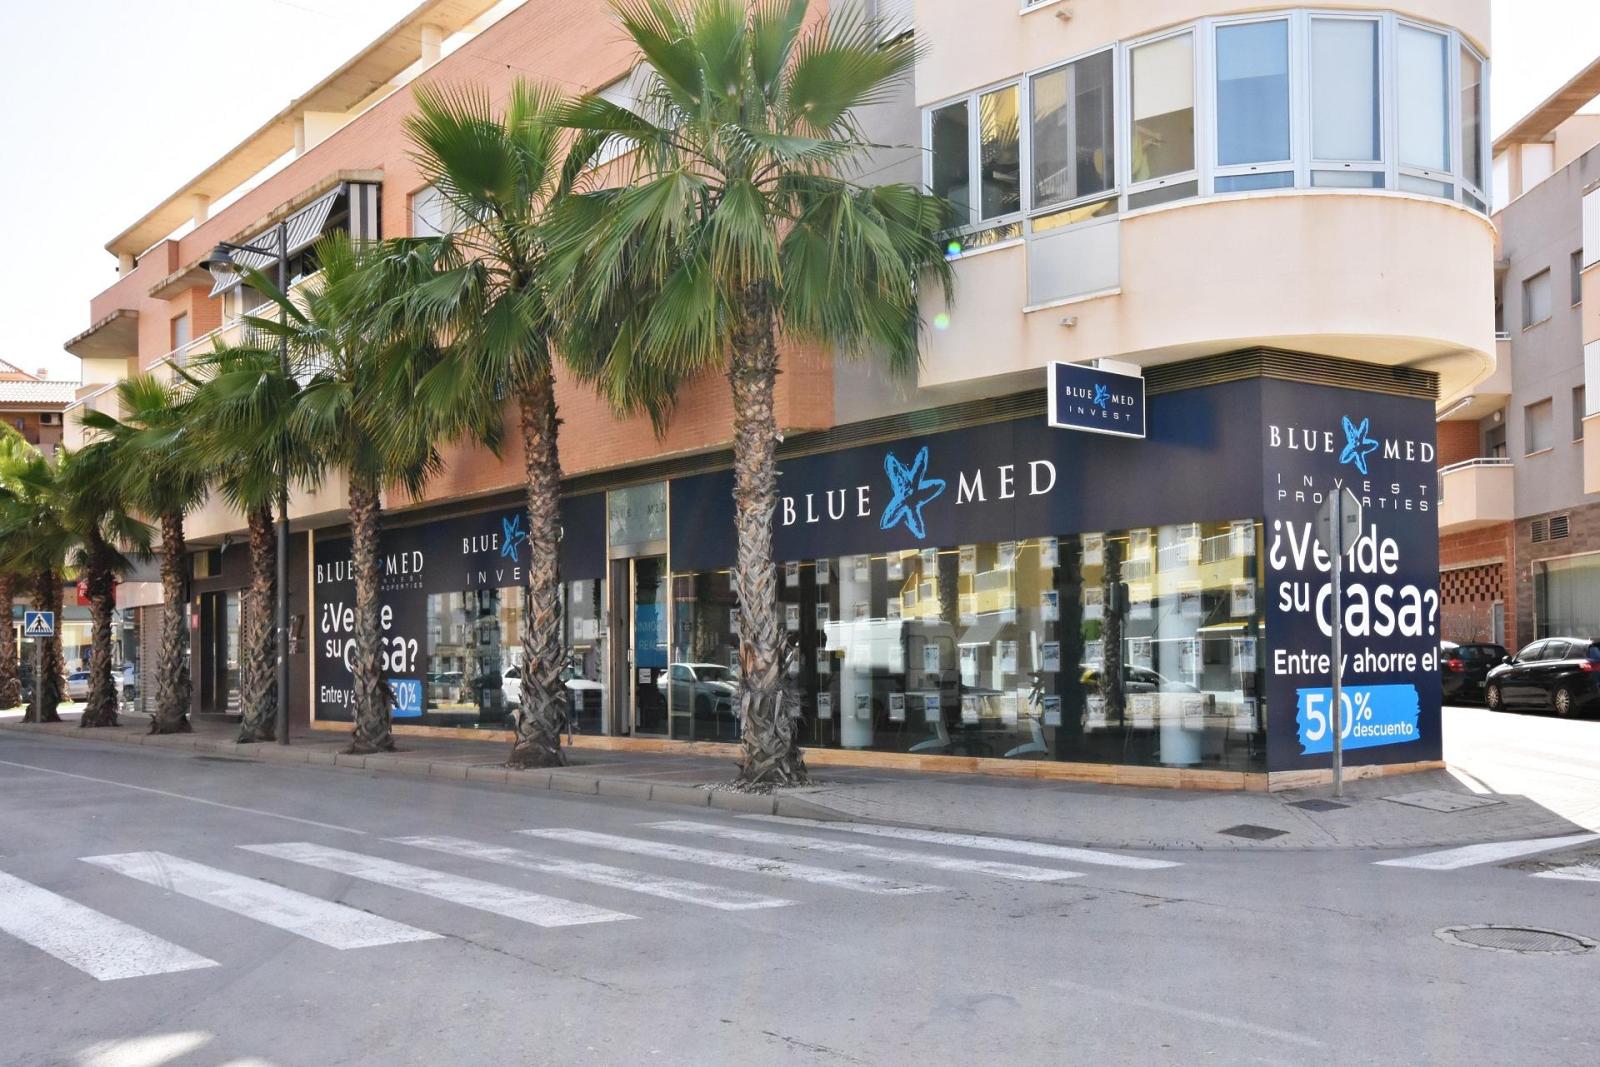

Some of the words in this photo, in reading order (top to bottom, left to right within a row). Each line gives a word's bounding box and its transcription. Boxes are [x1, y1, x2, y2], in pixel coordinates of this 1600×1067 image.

[1066, 386, 1092, 399] BLUE
[1111, 395, 1134, 406] MED
[1069, 405, 1131, 422] INVEST
[1269, 425, 1334, 453] BLUE
[1383, 439, 1435, 463] MED
[782, 485, 871, 526] BLUE
[955, 459, 1057, 505] MED
[1277, 473, 1428, 496] INVEST
[1278, 490, 1429, 512] PRORTIES
[463, 533, 499, 554] BLUE
[317, 560, 354, 584] BLUE
[385, 551, 424, 576] MED
[467, 567, 521, 585] INVE
[1278, 581, 1310, 613] su
[321, 602, 393, 634] ¿Vee
[326, 639, 341, 658] su
[1274, 649, 1331, 675] Entre
[1353, 647, 1417, 673] ahorre
[1422, 646, 1438, 672] el
[321, 685, 342, 703] Entre
[343, 690, 349, 708] y
[1353, 720, 1413, 738] descuento
